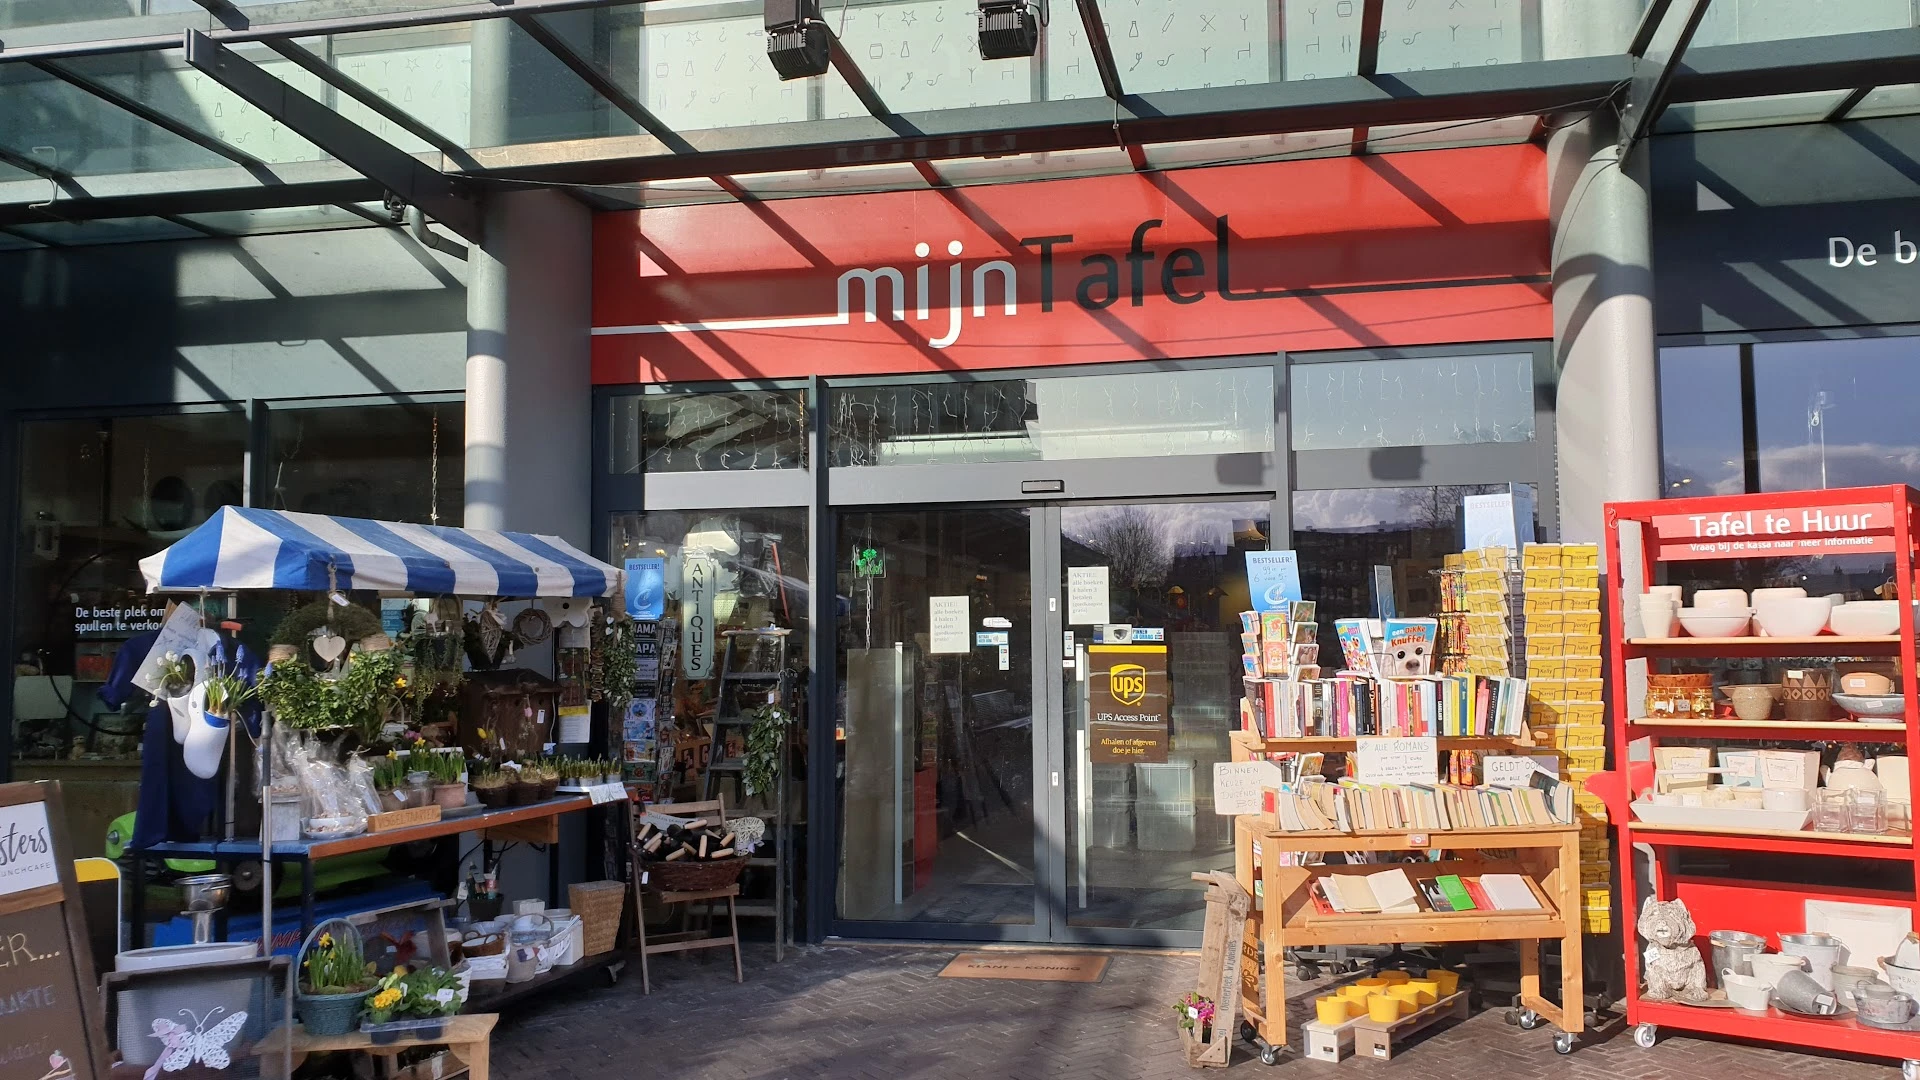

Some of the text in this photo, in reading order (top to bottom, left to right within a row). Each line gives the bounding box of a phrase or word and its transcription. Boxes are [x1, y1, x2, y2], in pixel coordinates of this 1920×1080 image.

[1828, 229, 1920, 268] De b
[1688, 509, 1873, 538] Tafel te Huur
[1690, 536, 1874, 553] Vraag bij de kassa naar meer informatie
[628, 563, 660, 571] BESTSELLER!
[75, 607, 89, 618] De
[93, 606, 121, 618] beste
[124, 605, 147, 620] plek
[690, 563, 704, 671] ANTIQUES
[75, 620, 113, 635] spullen
[116, 620, 127, 631] te
[635, 643, 657, 654] APA
[1096, 713, 1113, 721] UPS
[1113, 713, 1139, 722] Access
[1112, 746, 1124, 754] doe
[1125, 747, 1131, 755] je
[1133, 739, 1157, 747] afgeven
[1219, 766, 1259, 776] BINNEN
[0, 822, 47, 866] sters
